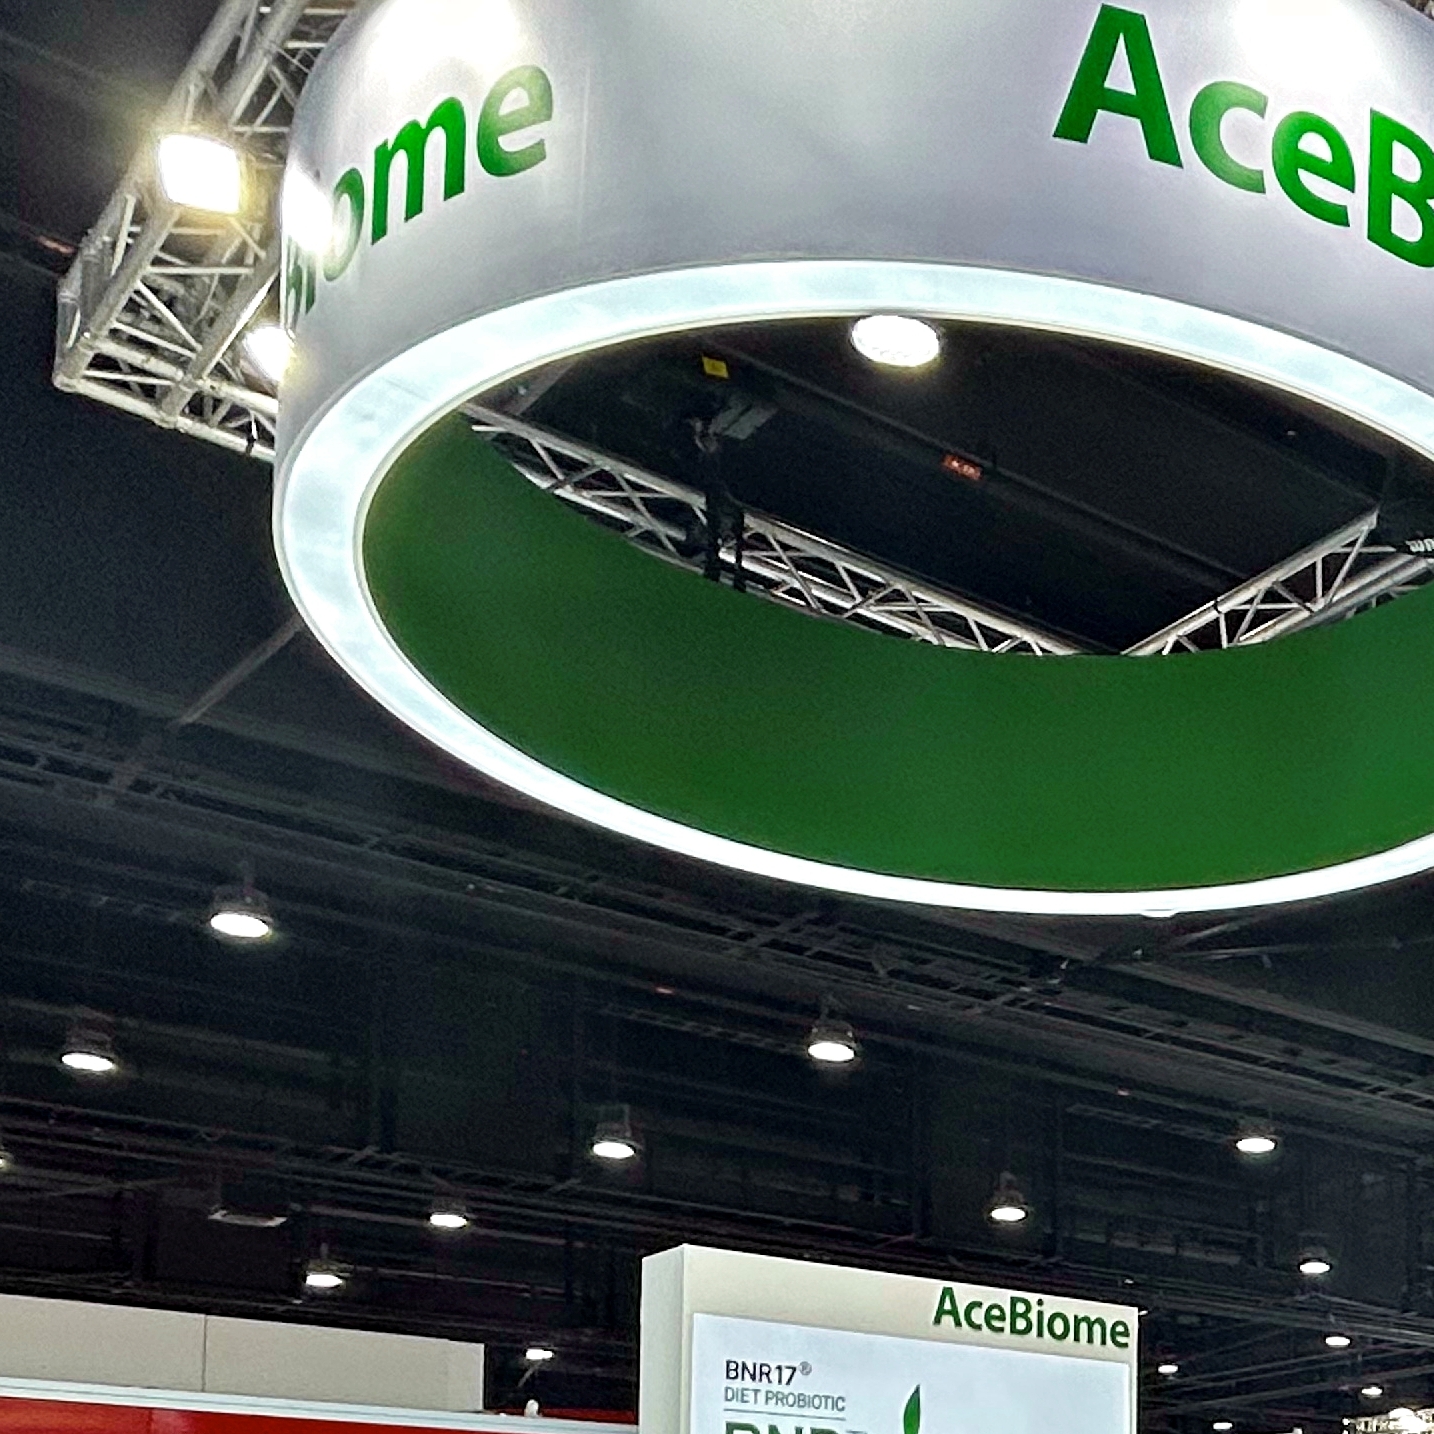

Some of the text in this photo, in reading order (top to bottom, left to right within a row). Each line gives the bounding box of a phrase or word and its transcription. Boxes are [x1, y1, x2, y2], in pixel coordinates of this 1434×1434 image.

[933, 1286, 1131, 1349] AceBiome
[724, 1386, 846, 1412] DIET PROBIOTIC
